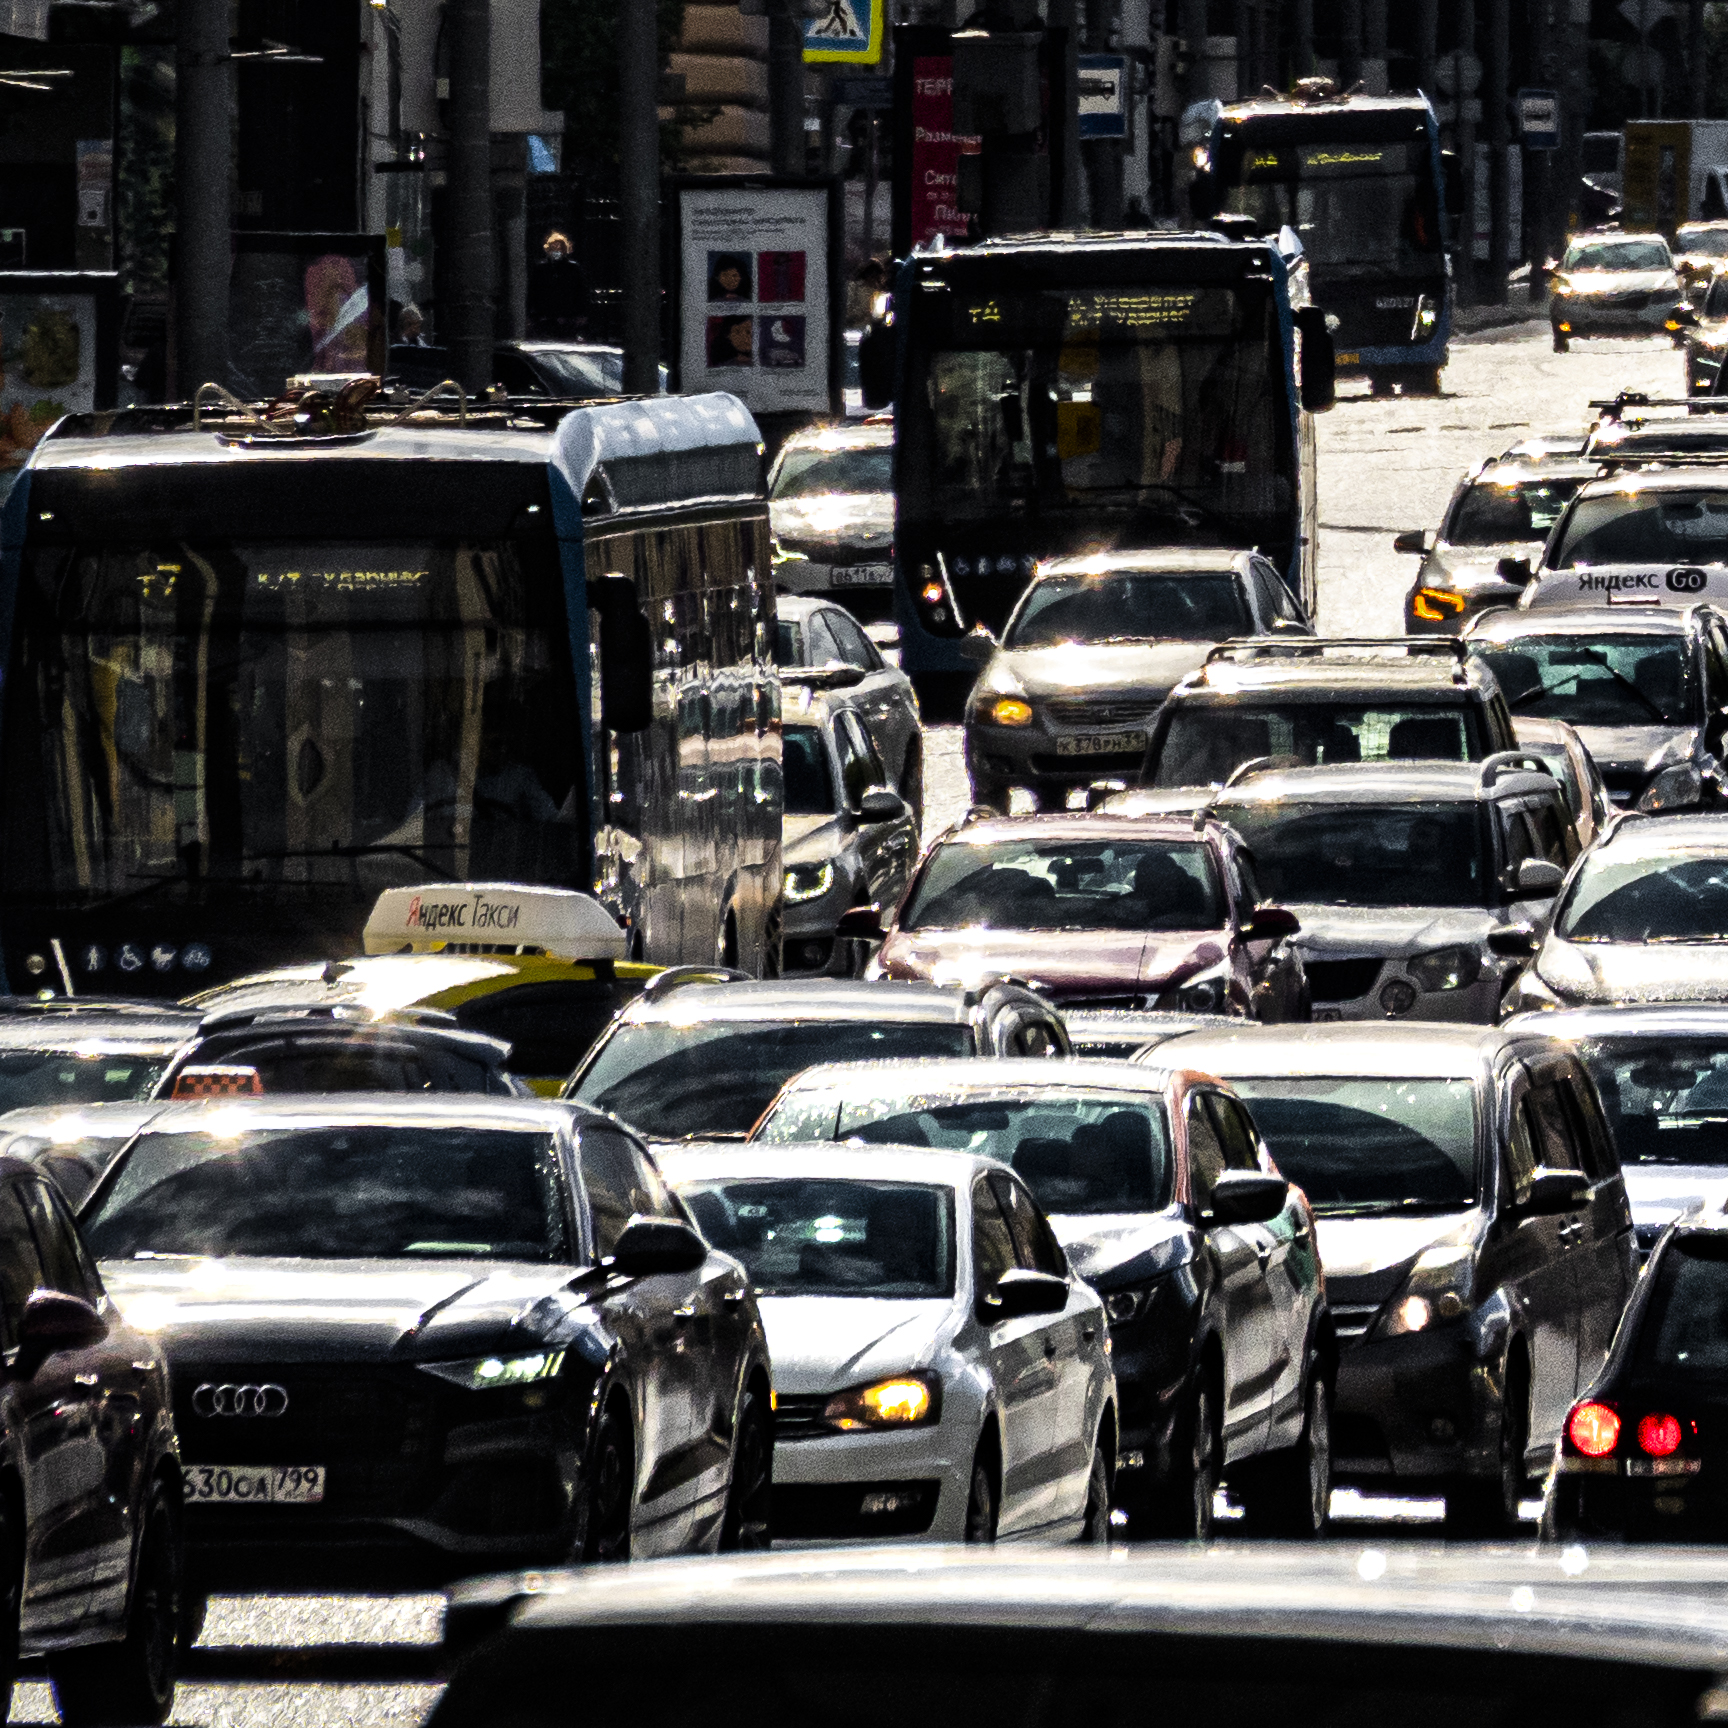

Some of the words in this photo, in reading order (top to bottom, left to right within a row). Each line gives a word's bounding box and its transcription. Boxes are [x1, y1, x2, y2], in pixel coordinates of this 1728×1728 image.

[1578, 573, 1660, 591] Яндекс
[1672, 570, 1702, 589] Go
[406, 895, 468, 931] Яндекс
[473, 894, 521, 928] Такси
[277, 1469, 319, 1492] 799
